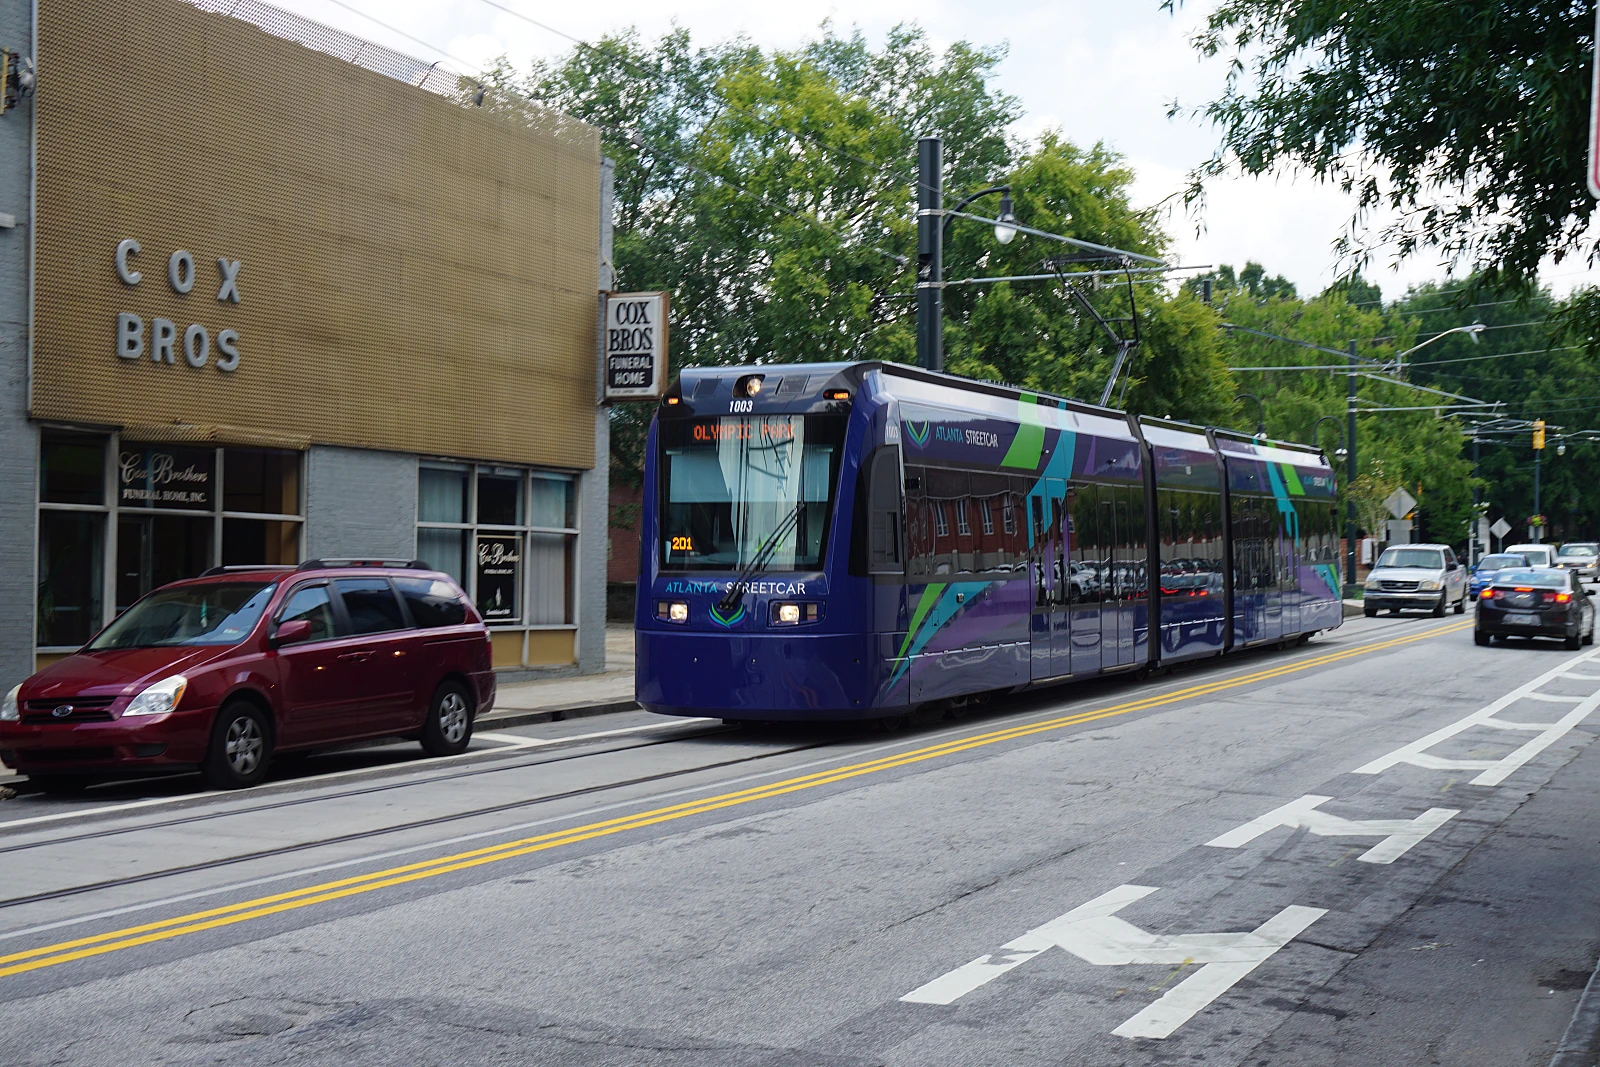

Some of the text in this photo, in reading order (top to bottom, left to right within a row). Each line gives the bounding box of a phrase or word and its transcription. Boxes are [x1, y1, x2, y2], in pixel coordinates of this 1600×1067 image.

[116, 238, 241, 303] COX
[616, 301, 651, 324] COX
[117, 312, 241, 372] BROS
[608, 327, 653, 351] BROS
[610, 356, 652, 369] FUNERAL
[614, 371, 646, 385] HOME
[729, 401, 753, 412] 1003
[693, 423, 796, 440] OLYMPIC PARK
[935, 426, 999, 448] ATLANTA STREETCAR
[149, 453, 208, 484] Brothers
[123, 488, 162, 500] FUNERAL
[672, 537, 693, 550] 201
[665, 582, 806, 594] ATLANTA STREETCAR
